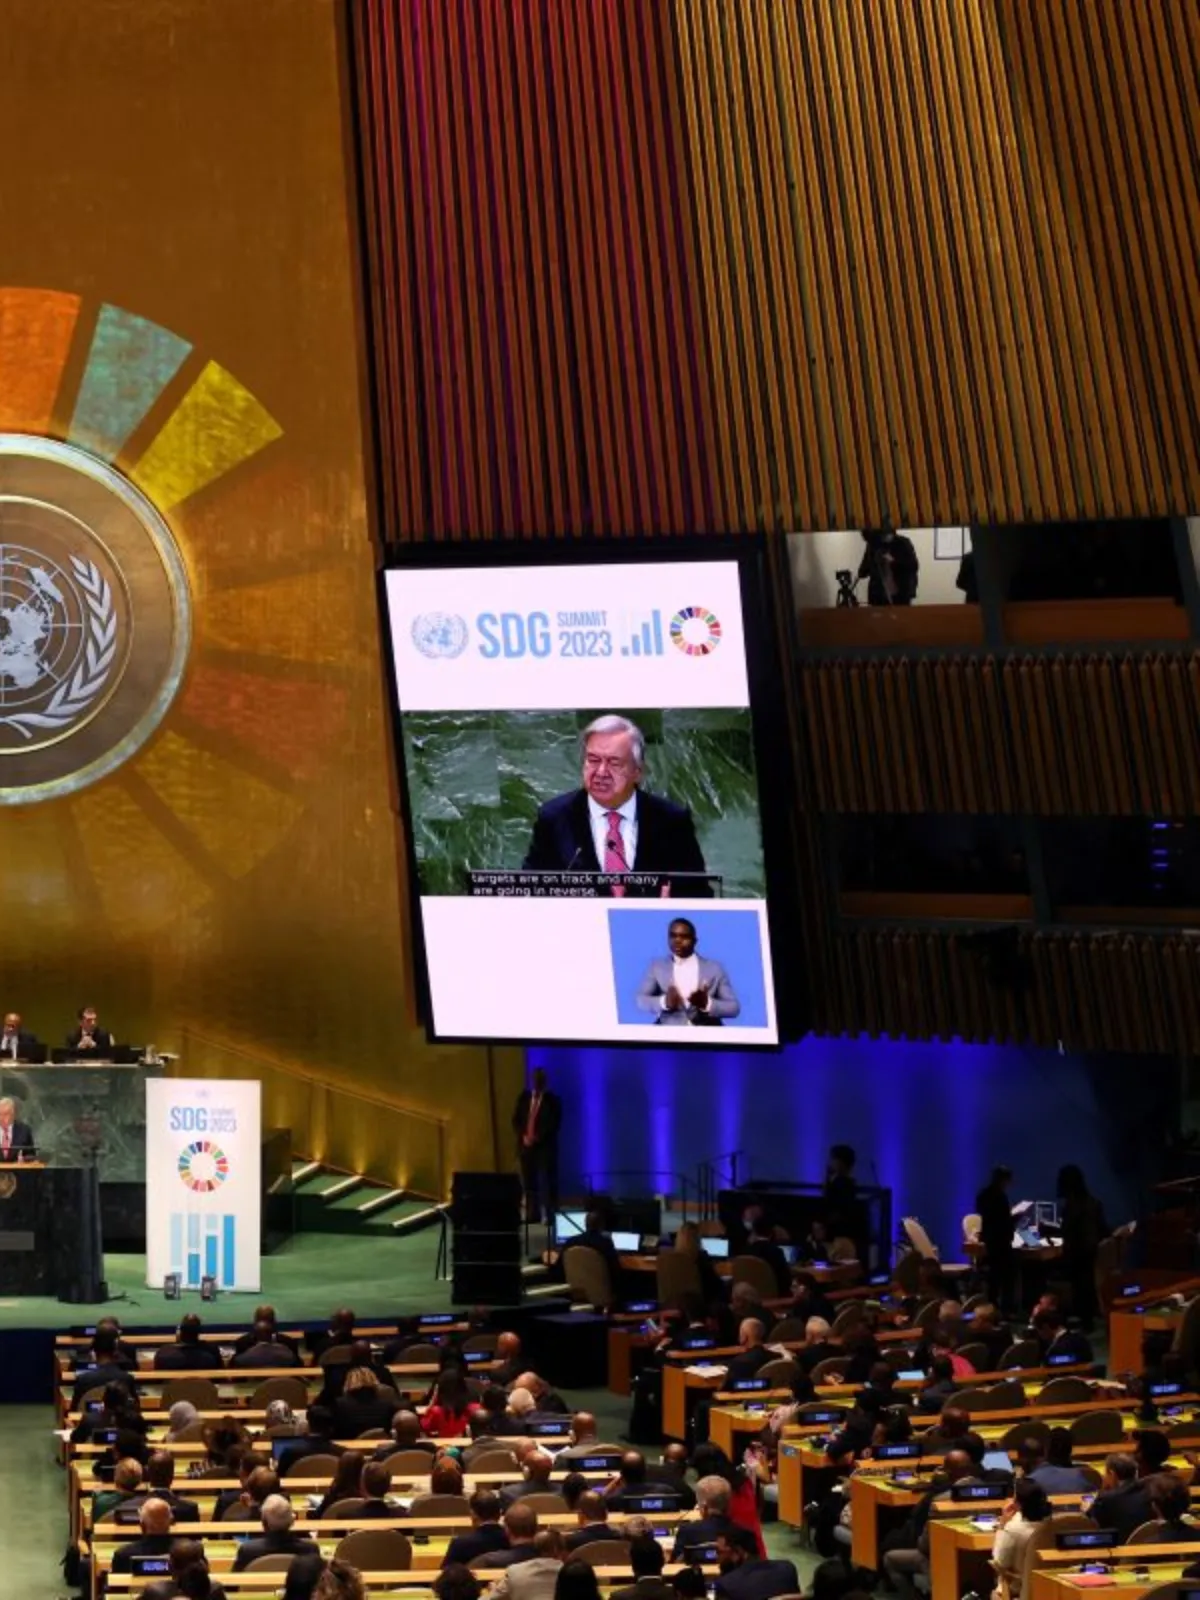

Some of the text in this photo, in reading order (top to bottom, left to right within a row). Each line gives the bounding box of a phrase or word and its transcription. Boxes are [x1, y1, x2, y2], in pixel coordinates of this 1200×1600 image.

[557, 611, 608, 627] SUMMIT
[476, 611, 551, 658] SDG
[559, 631, 612, 657] 2023
[471, 873, 659, 886] targets are on track and many
[473, 886, 598, 897] are going in reverse.
[170, 1106, 207, 1131] SDG
